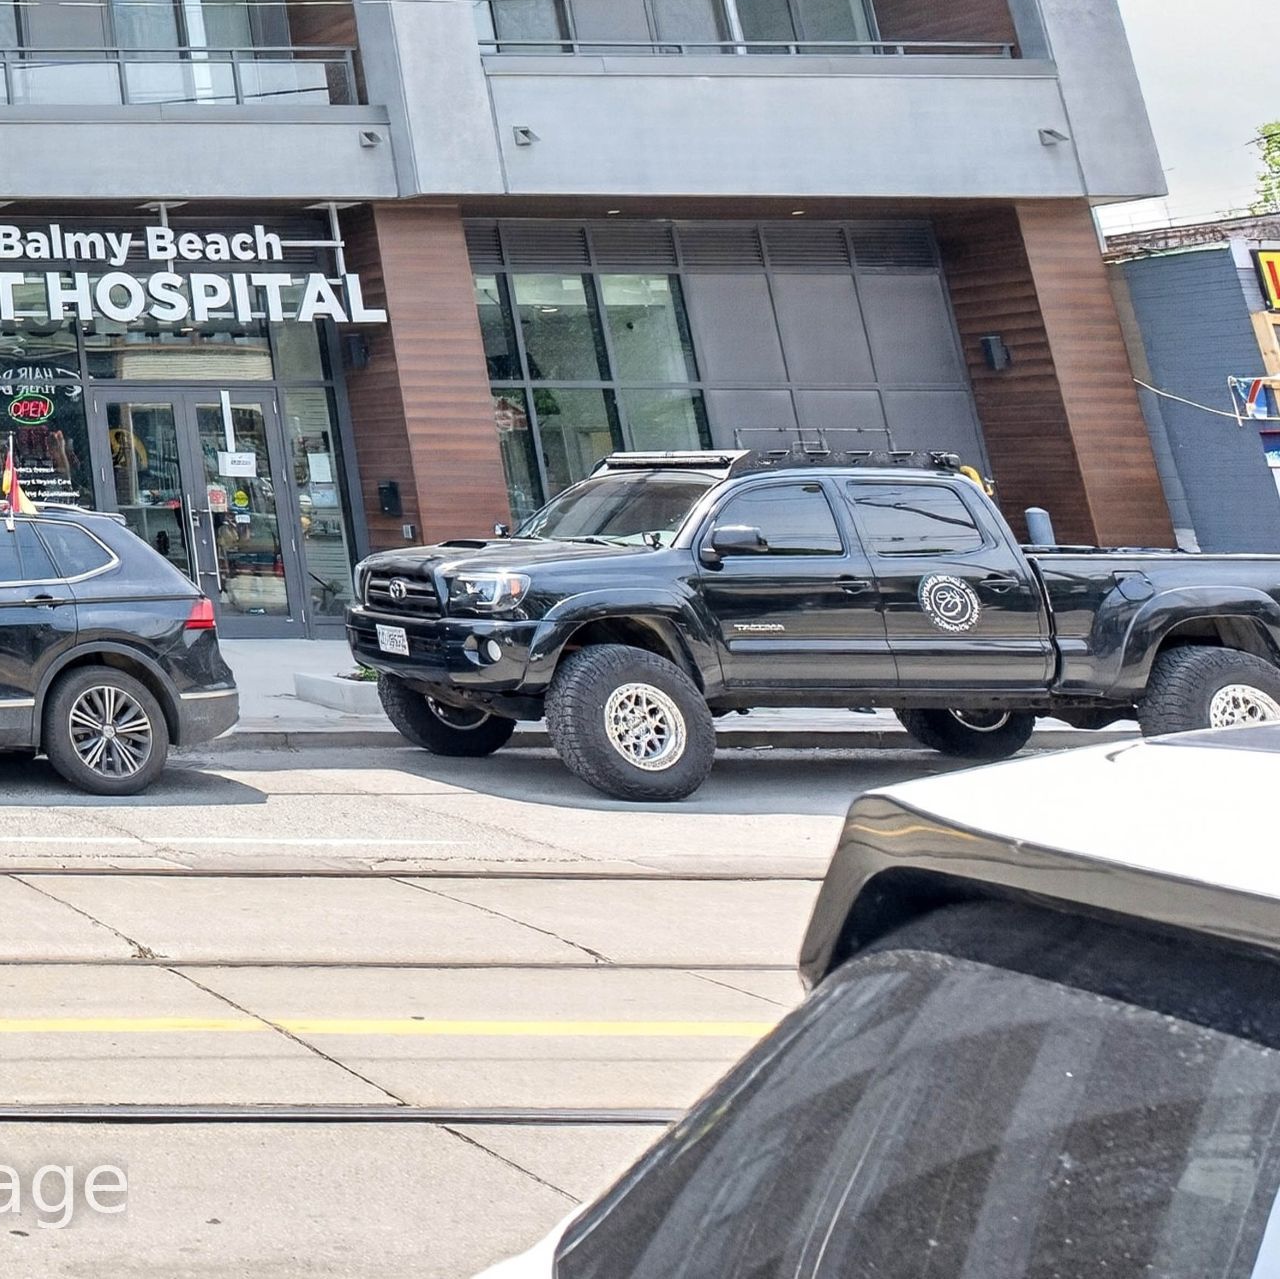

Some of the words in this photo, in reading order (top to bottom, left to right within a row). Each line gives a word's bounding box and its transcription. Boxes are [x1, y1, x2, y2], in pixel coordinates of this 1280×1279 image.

[145, 225, 283, 261] Beach
[45, 271, 387, 323] HOSPITAL
[11, 400, 49, 417] OPEN
